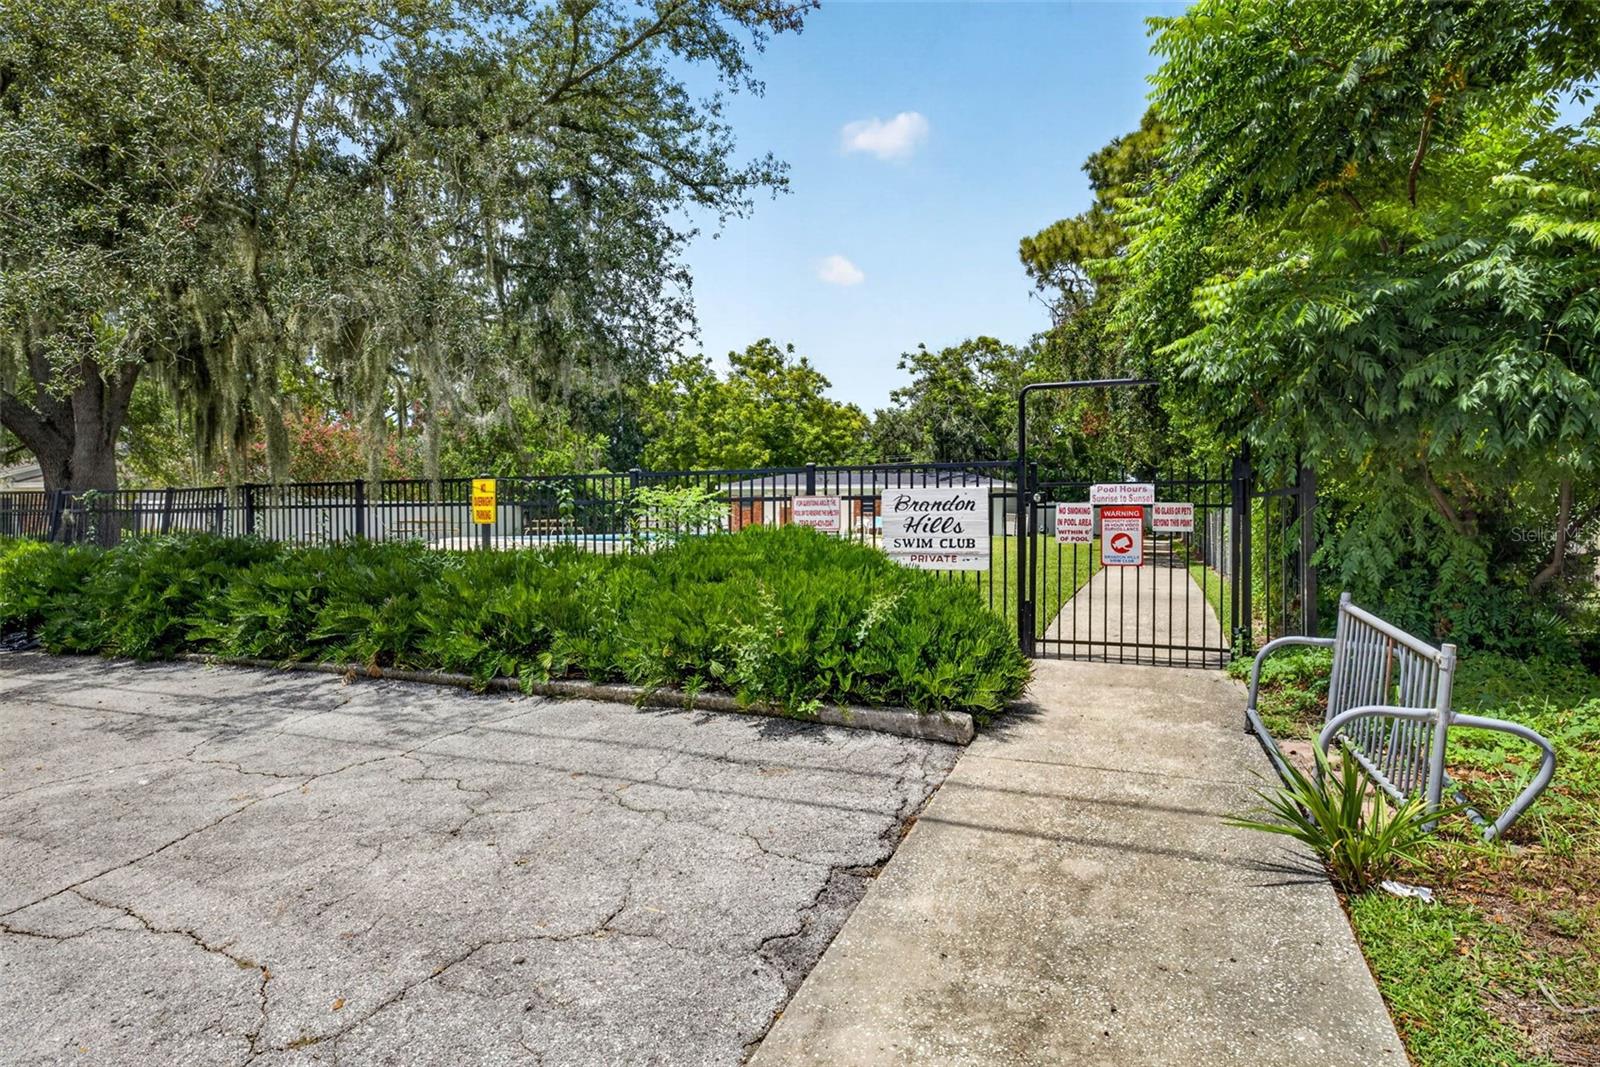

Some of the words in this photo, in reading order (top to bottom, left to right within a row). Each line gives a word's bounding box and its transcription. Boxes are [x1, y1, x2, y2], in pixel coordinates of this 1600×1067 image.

[1119, 485, 1148, 493] Hours
[1092, 494, 1118, 503] Sunrise
[1128, 494, 1153, 503] Sunset
[893, 494, 976, 513] Brandon
[1058, 507, 1066, 515] NO
[1067, 507, 1091, 515] SMOKING
[1154, 507, 1160, 515] NO
[1161, 507, 1174, 515] GLASS
[1174, 507, 1181, 515] OR
[1181, 507, 1192, 515] PETS
[903, 513, 965, 534] Hills
[1057, 518, 1063, 526] IN
[1063, 518, 1077, 526] POOL
[1078, 518, 1091, 526] AREA
[1153, 519, 1169, 527] BEYOND
[1170, 519, 1180, 527] THIS
[1180, 519, 1192, 527] POINT
[894, 538, 933, 549] SWIM
[939, 538, 976, 549] CLUB
[910, 554, 958, 563] PRIVATE
